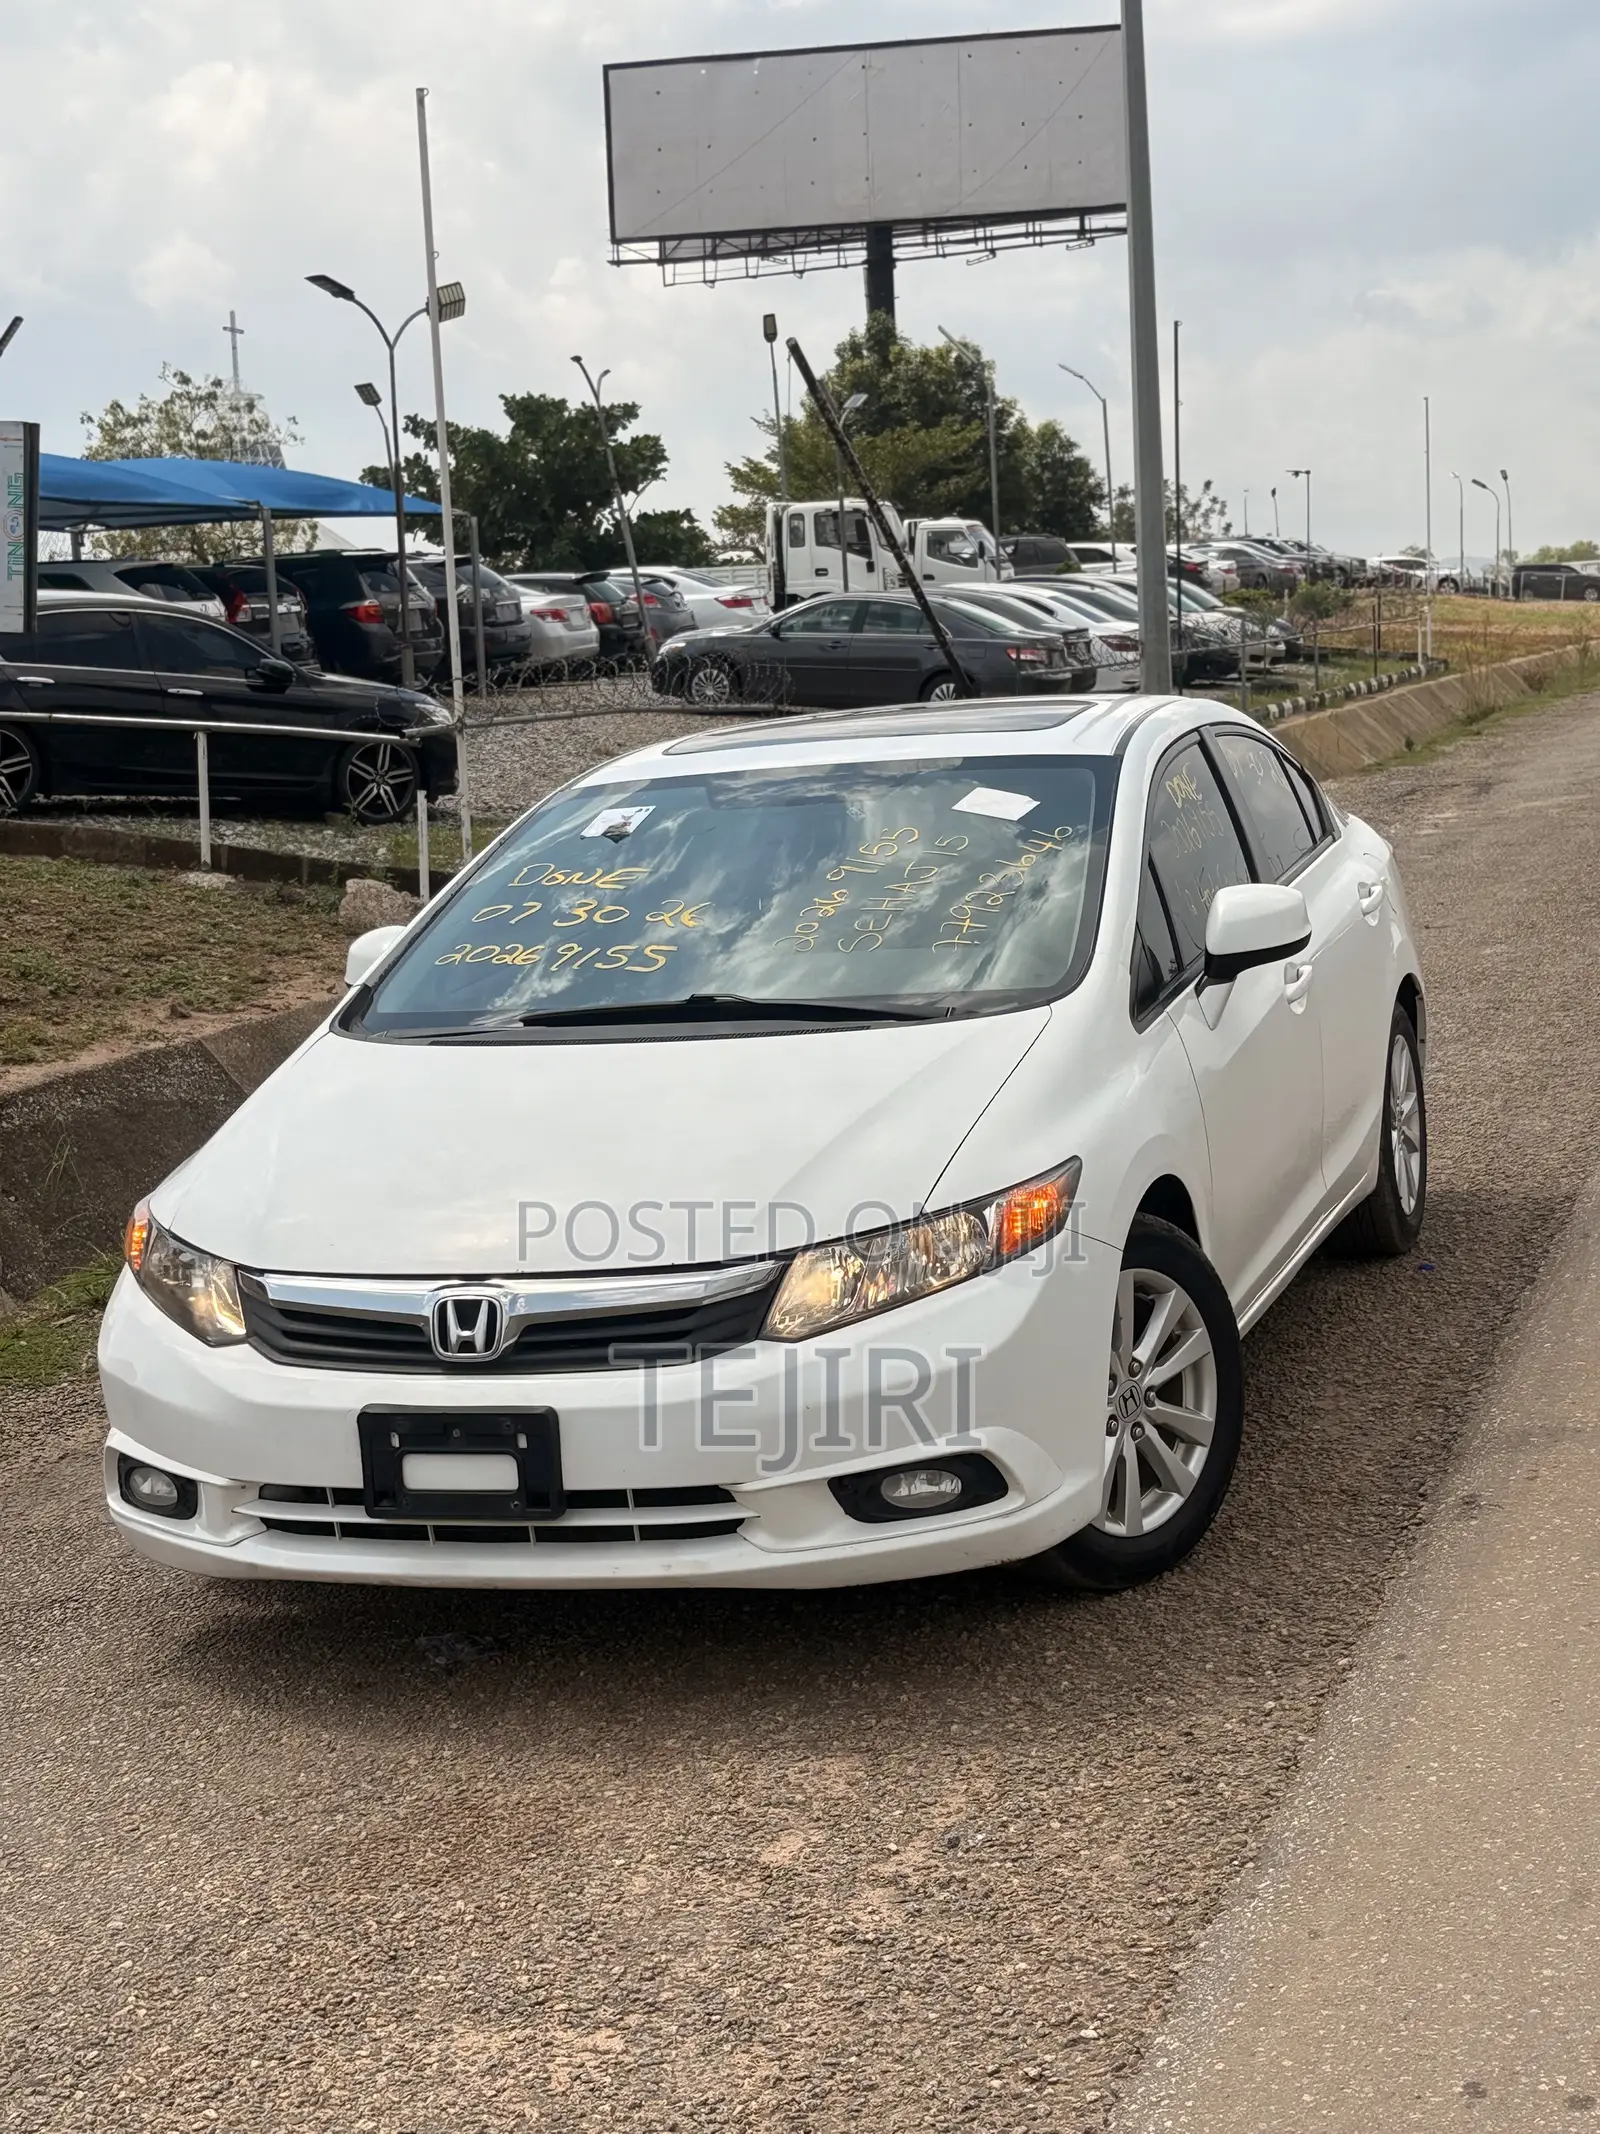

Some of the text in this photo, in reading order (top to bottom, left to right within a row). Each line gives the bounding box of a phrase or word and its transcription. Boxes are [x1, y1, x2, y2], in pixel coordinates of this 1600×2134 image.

[472, 898, 712, 928] 07 30 26
